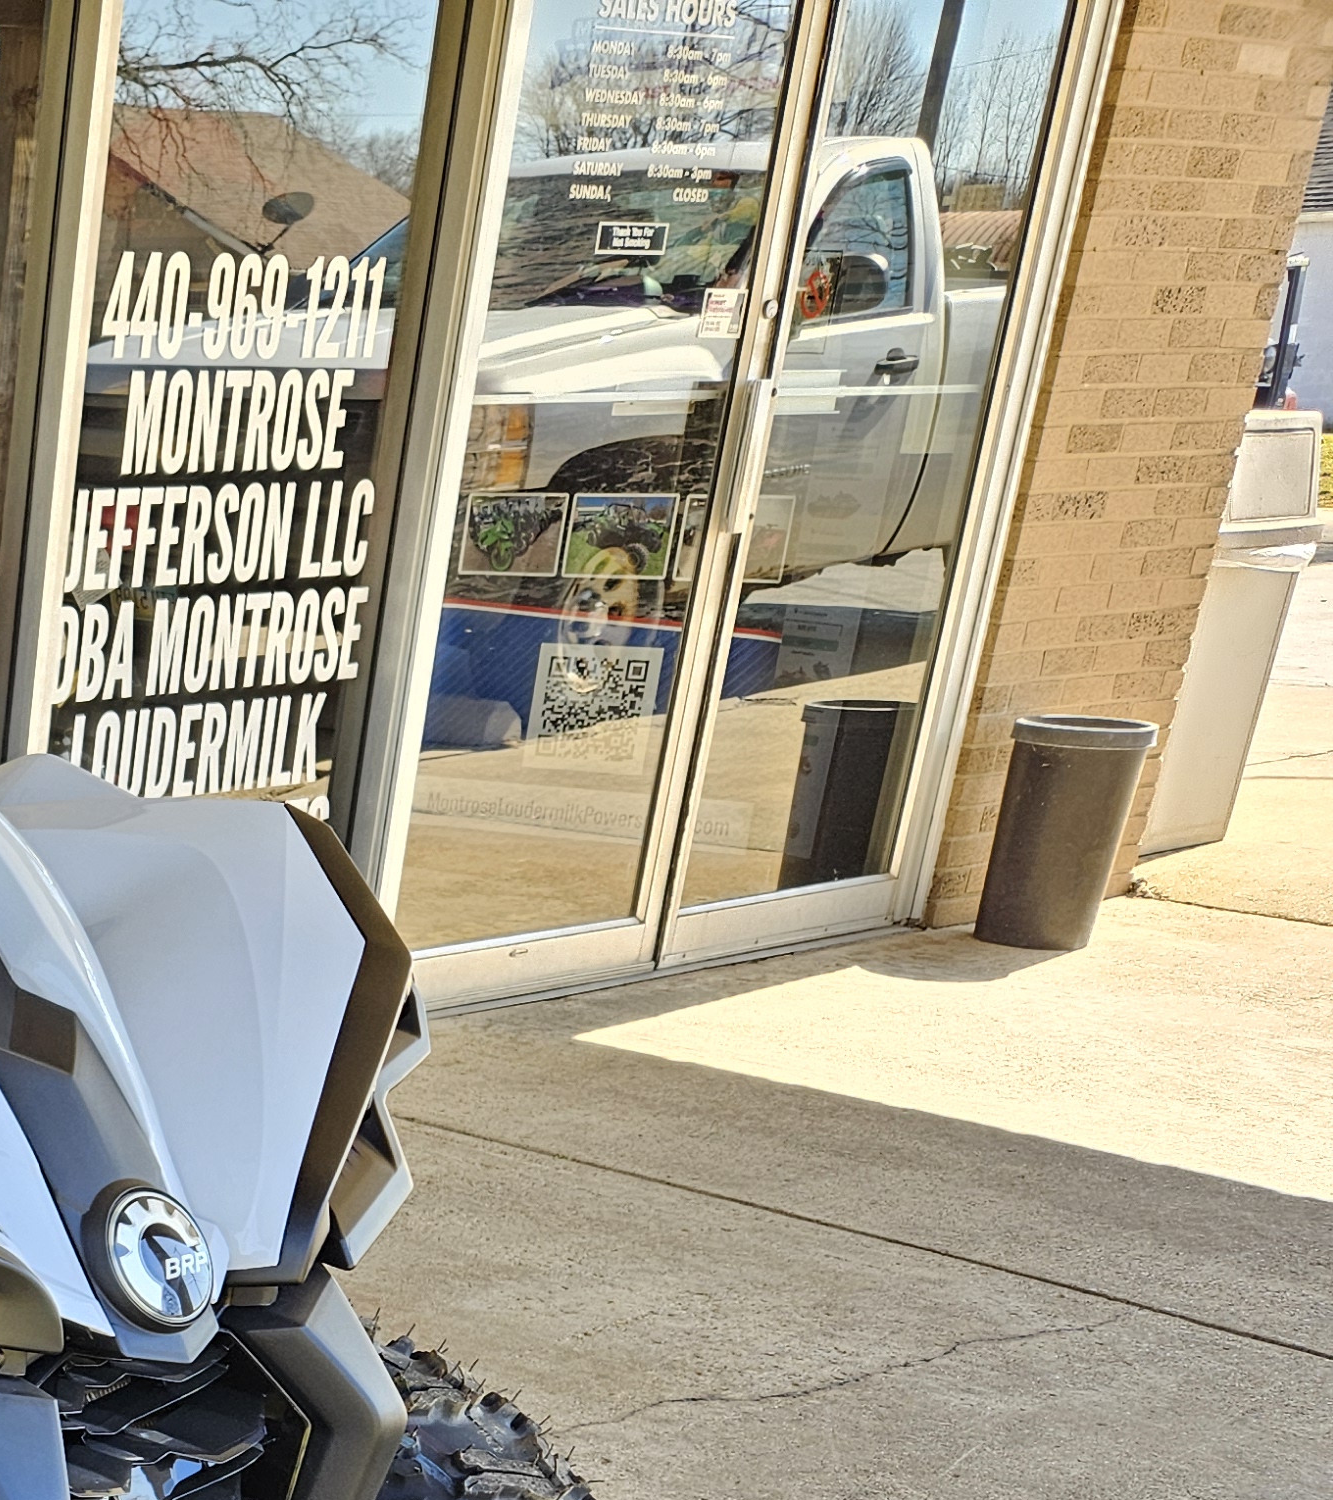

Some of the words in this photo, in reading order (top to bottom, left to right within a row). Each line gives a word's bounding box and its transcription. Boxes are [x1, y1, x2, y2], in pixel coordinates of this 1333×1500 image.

[598, 0, 659, 21] SALES
[665, 0, 736, 27] HOURS
[591, 40, 635, 56] MONDAY
[667, 45, 703, 61] 8:30am
[711, 49, 731, 63] 7pm
[588, 63, 630, 80] TUESDAY
[663, 69, 698, 85] 8:30am
[707, 72, 728, 87] 6pm
[585, 88, 645, 106] WEDNESDAY
[659, 93, 695, 108] 8:30am
[703, 96, 724, 112] 6pm
[582, 112, 632, 129] THURSDAY
[656, 116, 692, 132] 8:30am
[699, 120, 720, 134] 7pm
[577, 137, 612, 152] FRIDAY
[652, 141, 688, 156] 8:30am
[695, 143, 716, 158] 6pm
[572, 161, 624, 177] SATURDAY
[647, 164, 683, 180] 8:30am
[691, 166, 712, 182] 3pm
[673, 188, 709, 203] CLOSED
[101, 250, 388, 361] 440-969-1211
[120, 369, 356, 477] MONTROSE
[64, 481, 296, 594] JEFFERSON
[298, 478, 375, 578] LLC
[54, 600, 135, 704] DBA
[146, 586, 369, 697] MONTROSE
[165, 1251, 208, 1281] BRP
